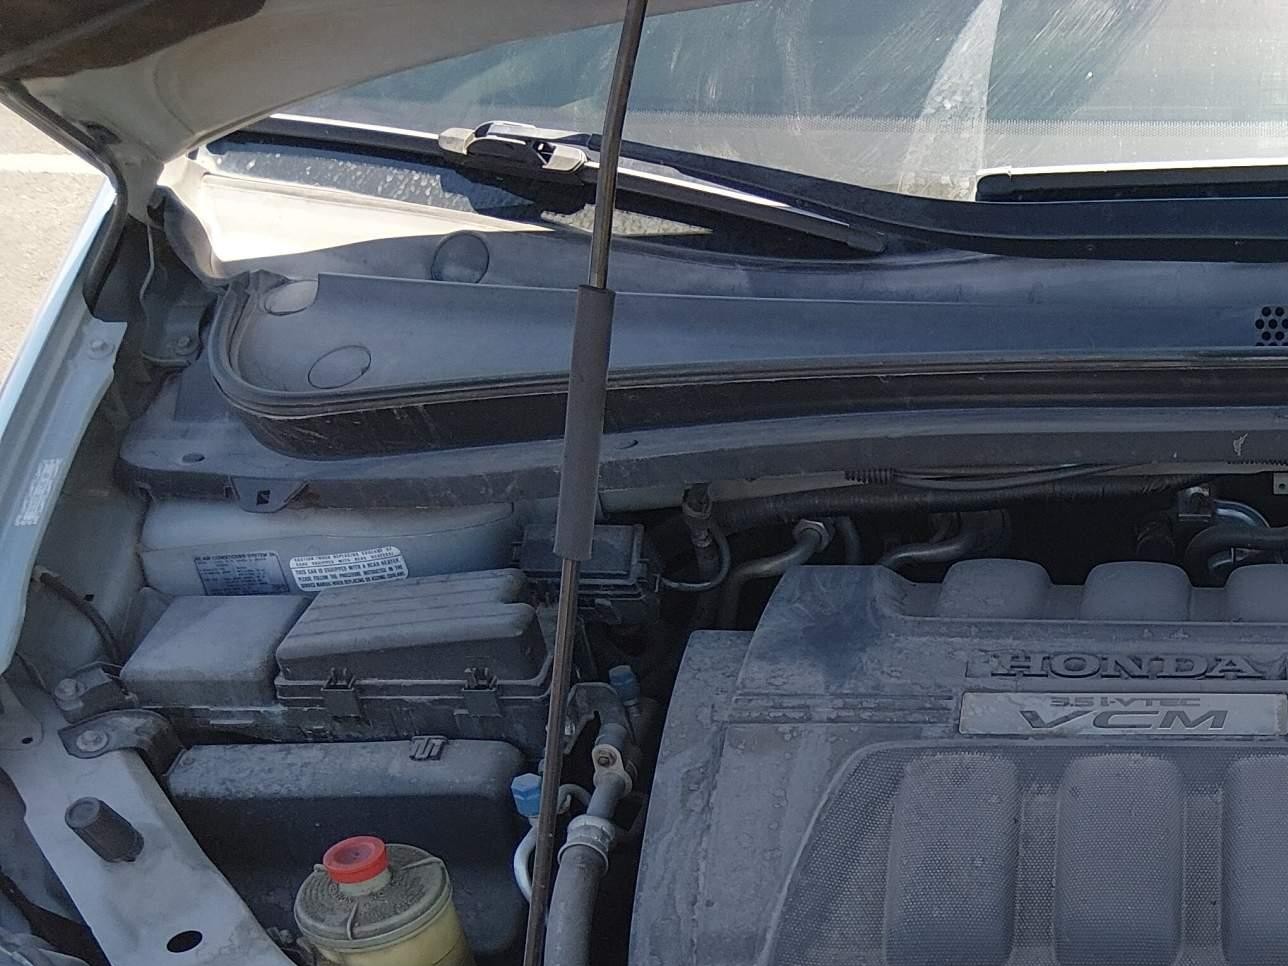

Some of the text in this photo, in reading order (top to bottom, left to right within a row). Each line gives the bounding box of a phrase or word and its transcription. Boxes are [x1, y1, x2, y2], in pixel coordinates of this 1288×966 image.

[990, 654, 1263, 679] HONDA
[1050, 696, 1094, 707] 3.5
[1018, 710, 1230, 730] VCM
